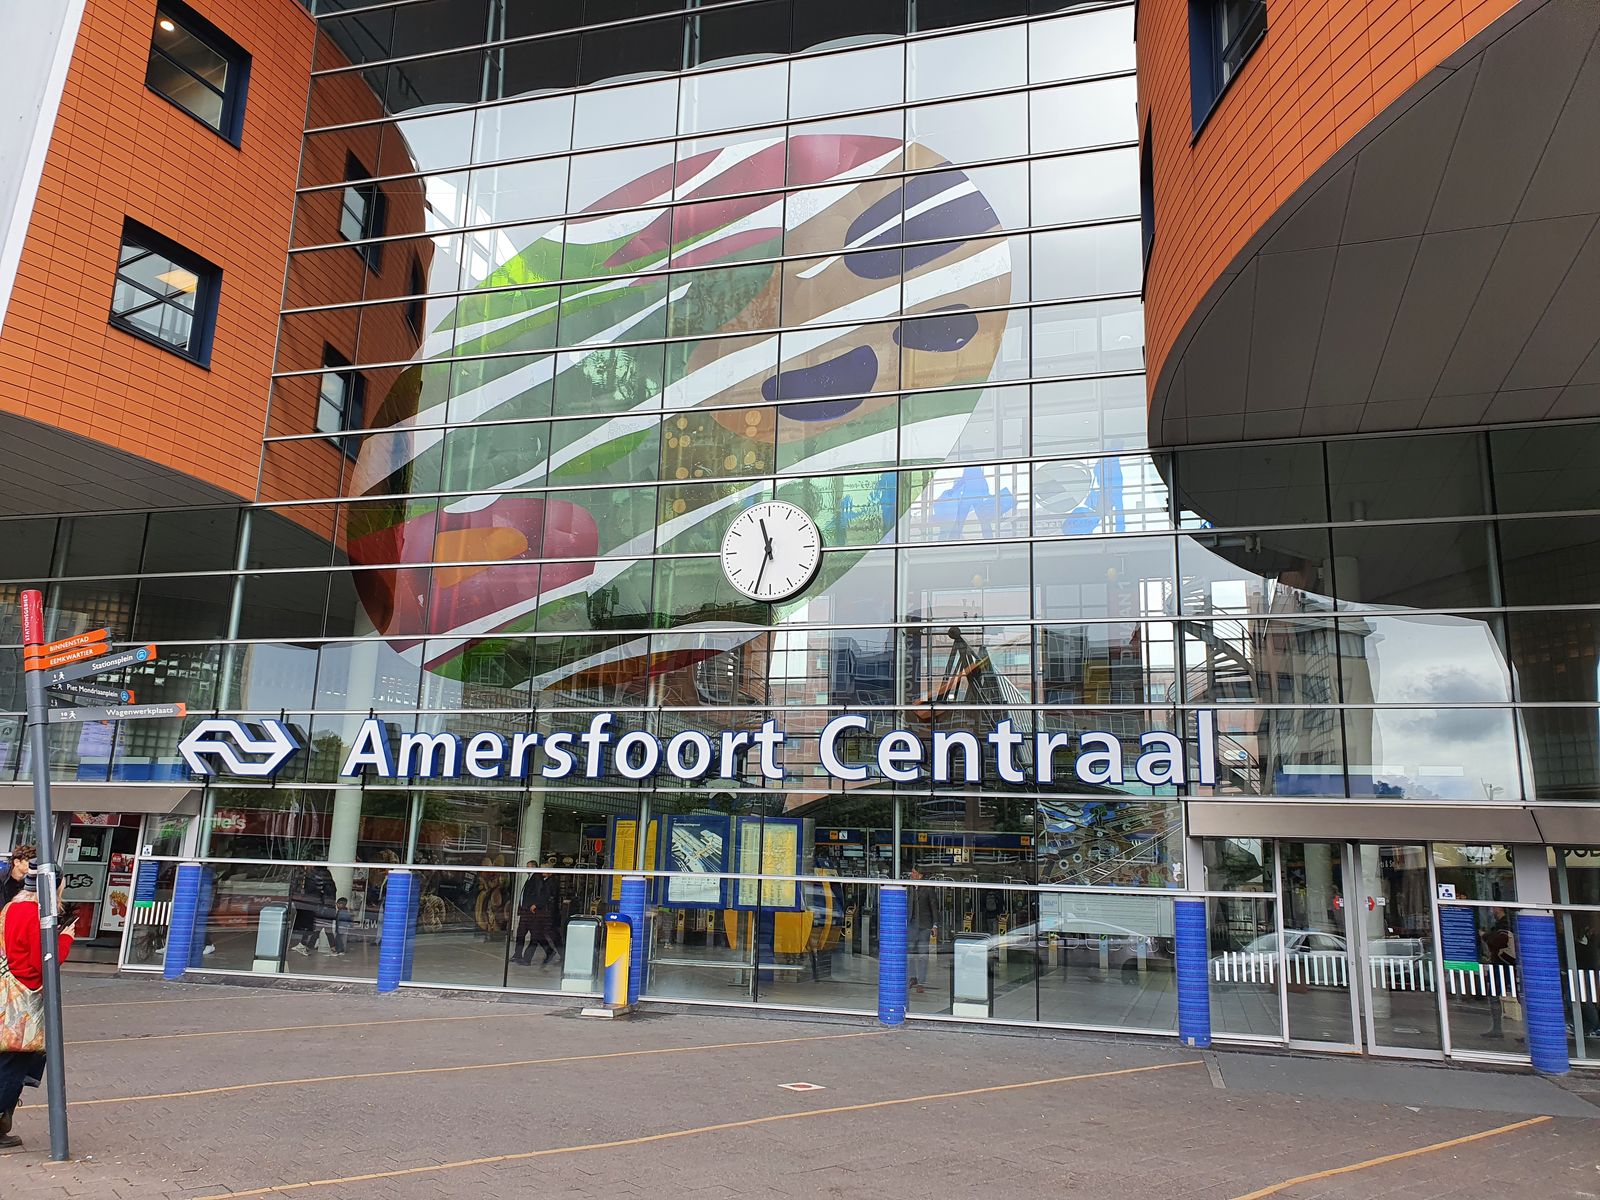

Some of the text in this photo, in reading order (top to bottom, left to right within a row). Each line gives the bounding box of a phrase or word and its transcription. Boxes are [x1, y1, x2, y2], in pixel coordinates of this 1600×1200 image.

[49, 636, 89, 652] BINNENSTAD
[49, 649, 94, 665] EEMKWARTIER
[91, 655, 133, 670] Stationsplein
[66, 684, 78, 692] Piet
[78, 686, 119, 698] Mondriaanplein
[105, 707, 174, 718] Wagenwerkplaats
[341, 709, 1218, 785] Amersfoort Centraal
